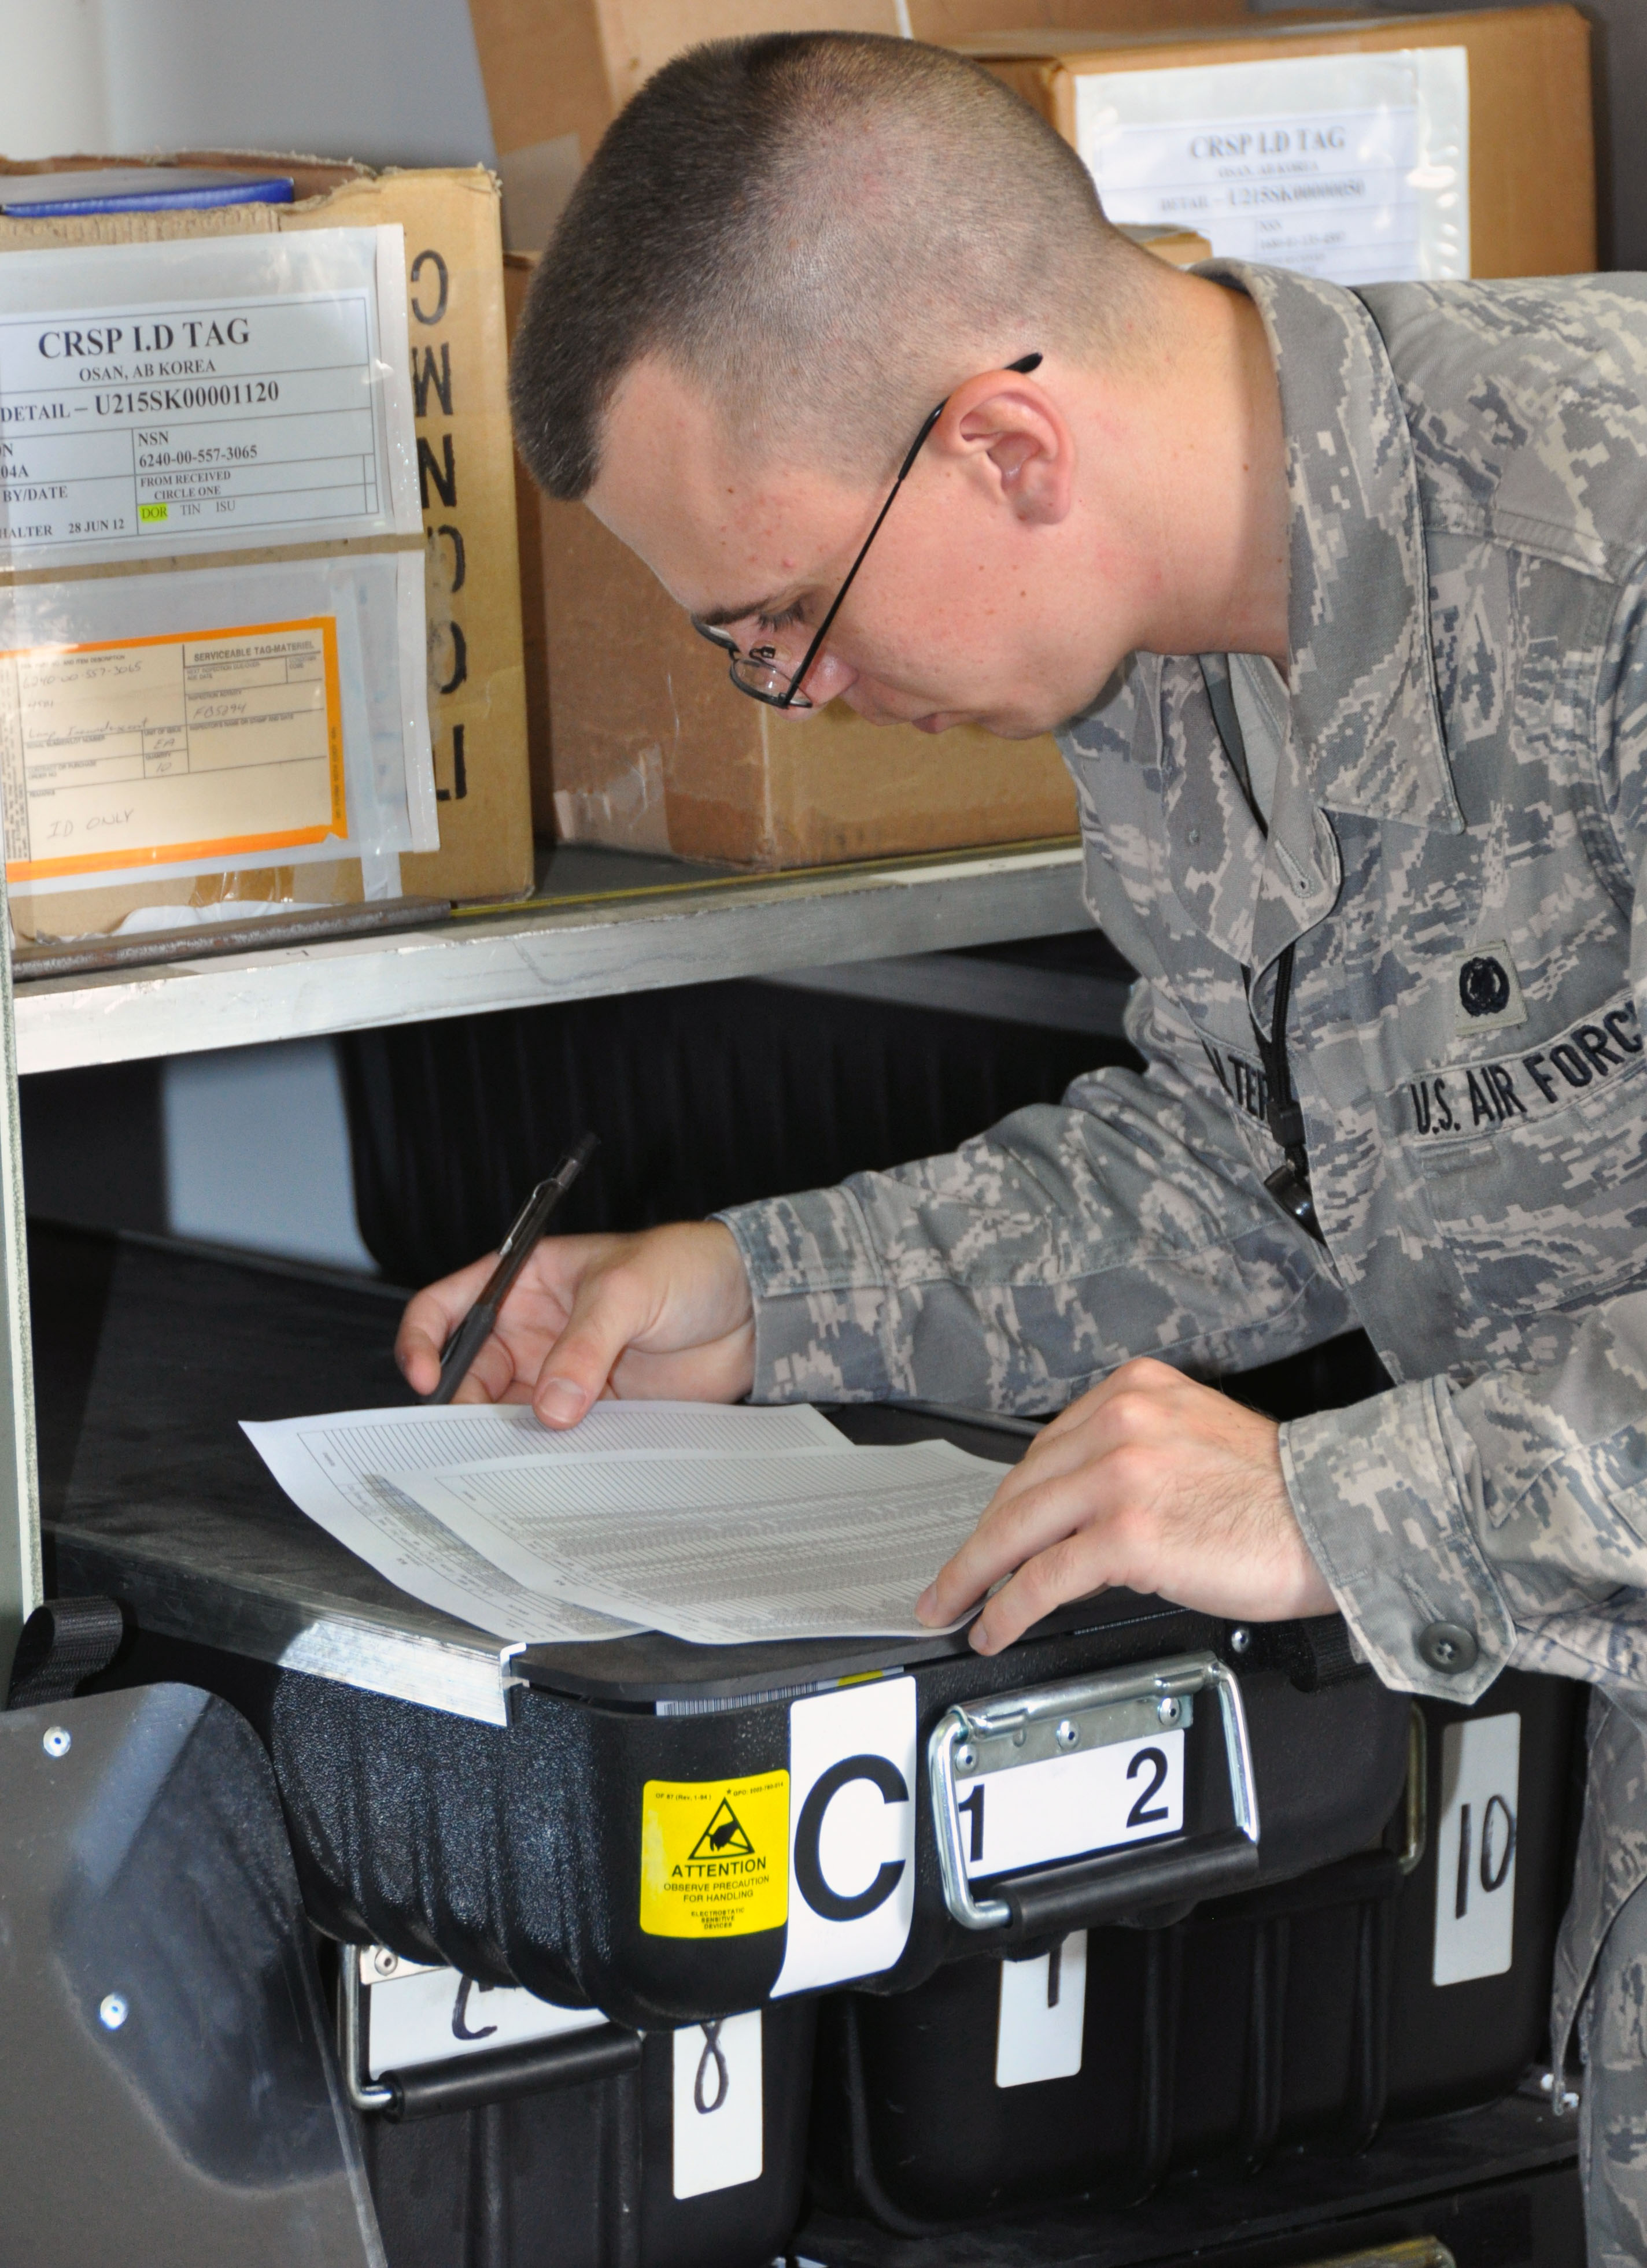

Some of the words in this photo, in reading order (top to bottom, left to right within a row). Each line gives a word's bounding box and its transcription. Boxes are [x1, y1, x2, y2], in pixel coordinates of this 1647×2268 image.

[1190, 132, 1253, 158] CRSP
[1297, 125, 1346, 151] TAG
[39, 327, 123, 359] CRSP
[132, 324, 174, 352] I.D
[182, 317, 250, 348] TAG
[79, 366, 128, 382] OSAN,
[132, 363, 154, 378] AB
[159, 359, 216, 375] KOREA
[0, 404, 71, 423] DETAIL
[95, 380, 279, 416] U215SK00001120
[138, 431, 169, 446] NSN
[139, 445, 258, 468] 6240-00-557-3065
[140, 475, 172, 488] FROM
[175, 471, 231, 485] RECEIVED
[3, 486, 68, 503] BY/DATE
[154, 488, 195, 501] CIRCLE
[198, 485, 221, 496] ONE
[141, 506, 168, 520] DOR
[180, 504, 201, 516] TIN
[216, 500, 236, 512] ISU
[0, 524, 53, 539] HALTER
[68, 522, 82, 534] 28
[84, 520, 109, 532] JUN
[113, 519, 125, 530] 12
[194, 647, 252, 663] SERVICEABLE
[254, 641, 314, 656] TAG-MATERIEL
[1410, 1077, 1461, 1135] U.S.
[1466, 1065, 1528, 1126] AIR
[1522, 1000, 1643, 1104] FORC
[958, 1783, 985, 1863] 1
[1126, 1747, 1169, 1829] 2
[793, 1754, 910, 1922] C
[671, 1856, 767, 1878] ATTENTION
[1455, 1794, 1517, 1919] 10
[663, 1882, 710, 1892] OBSERVE
[712, 1875, 770, 1891] PRECAUTION
[683, 1893, 704, 1903] FOR
[706, 1890, 754, 1902] HANDLING
[691, 1907, 745, 1917] ELECTROSTATIC
[701, 1915, 735, 1923] SENSITIVE
[704, 1922, 733, 1930] DEVICES
